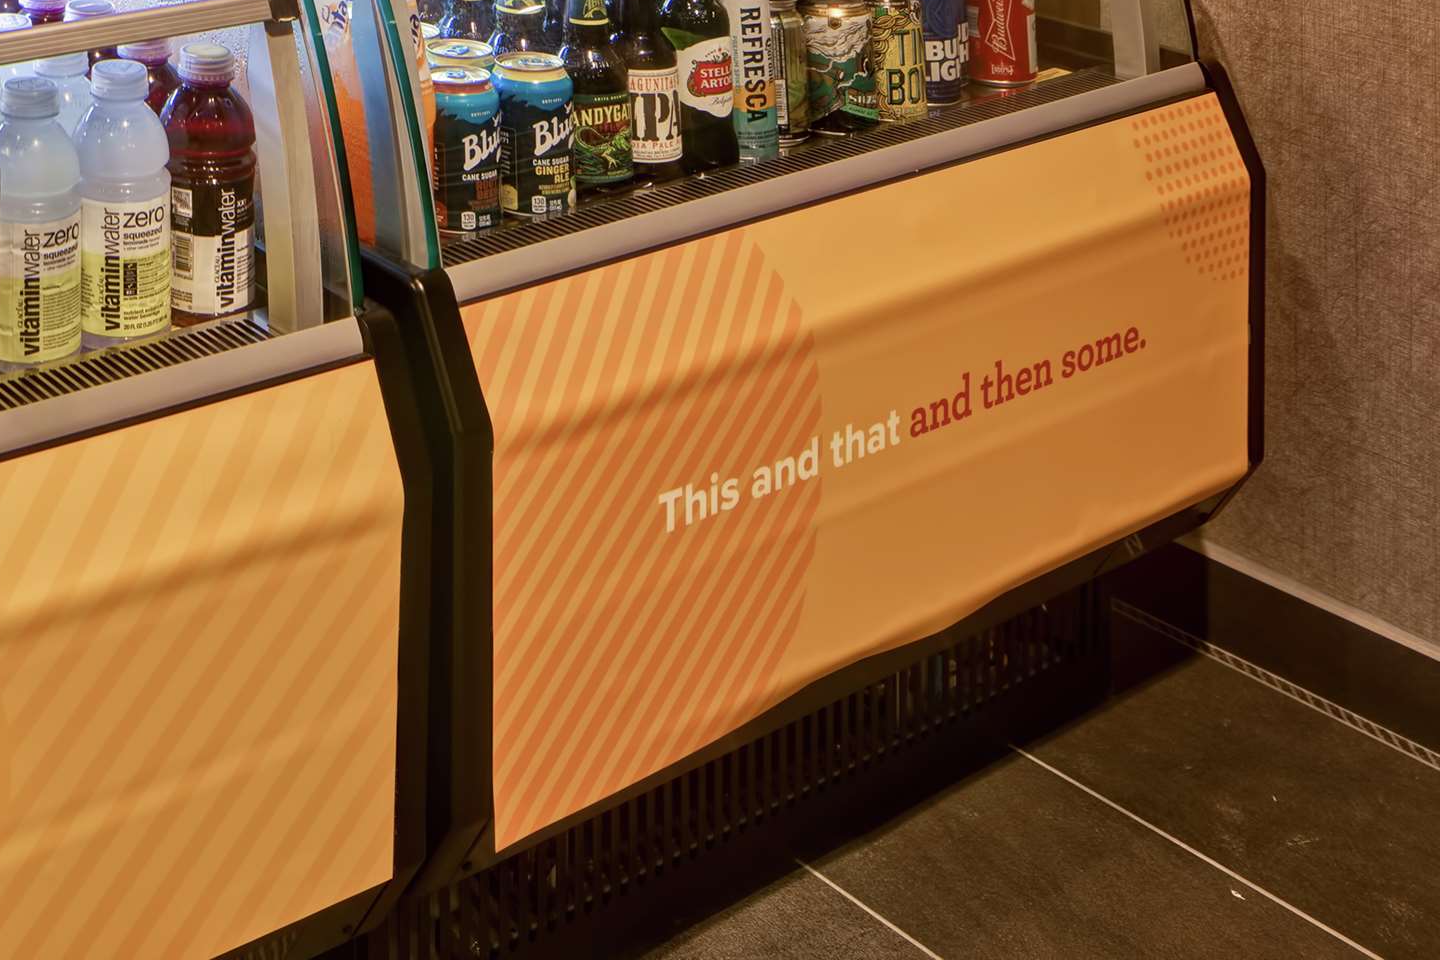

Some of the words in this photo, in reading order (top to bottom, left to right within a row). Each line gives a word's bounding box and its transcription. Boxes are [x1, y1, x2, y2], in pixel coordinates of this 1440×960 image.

[925, 38, 959, 62] BU
[700, 65, 733, 79] STELL
[740, 7, 768, 123] REFRESCA
[924, 60, 961, 83] LIG
[700, 75, 733, 89] ARTO
[631, 89, 682, 142] IPA
[532, 113, 574, 156] Blu
[462, 125, 500, 171] Blu
[532, 158, 551, 167] CANE
[552, 155, 569, 164] SUGAR
[535, 164, 570, 177] GINGER
[462, 174, 480, 182] CANE
[481, 169, 498, 180] SUGAR
[554, 174, 570, 184] ALE
[533, 197, 545, 205] 130
[123, 205, 165, 229] zero
[42, 222, 80, 249] zero
[123, 225, 163, 241] squeezed
[43, 244, 79, 260] squeezed
[658, 471, 741, 535] This
[750, 436, 820, 501] and
[828, 408, 902, 469] that
[908, 371, 973, 438] and
[979, 357, 1054, 410] then
[1060, 325, 1148, 381] some.
